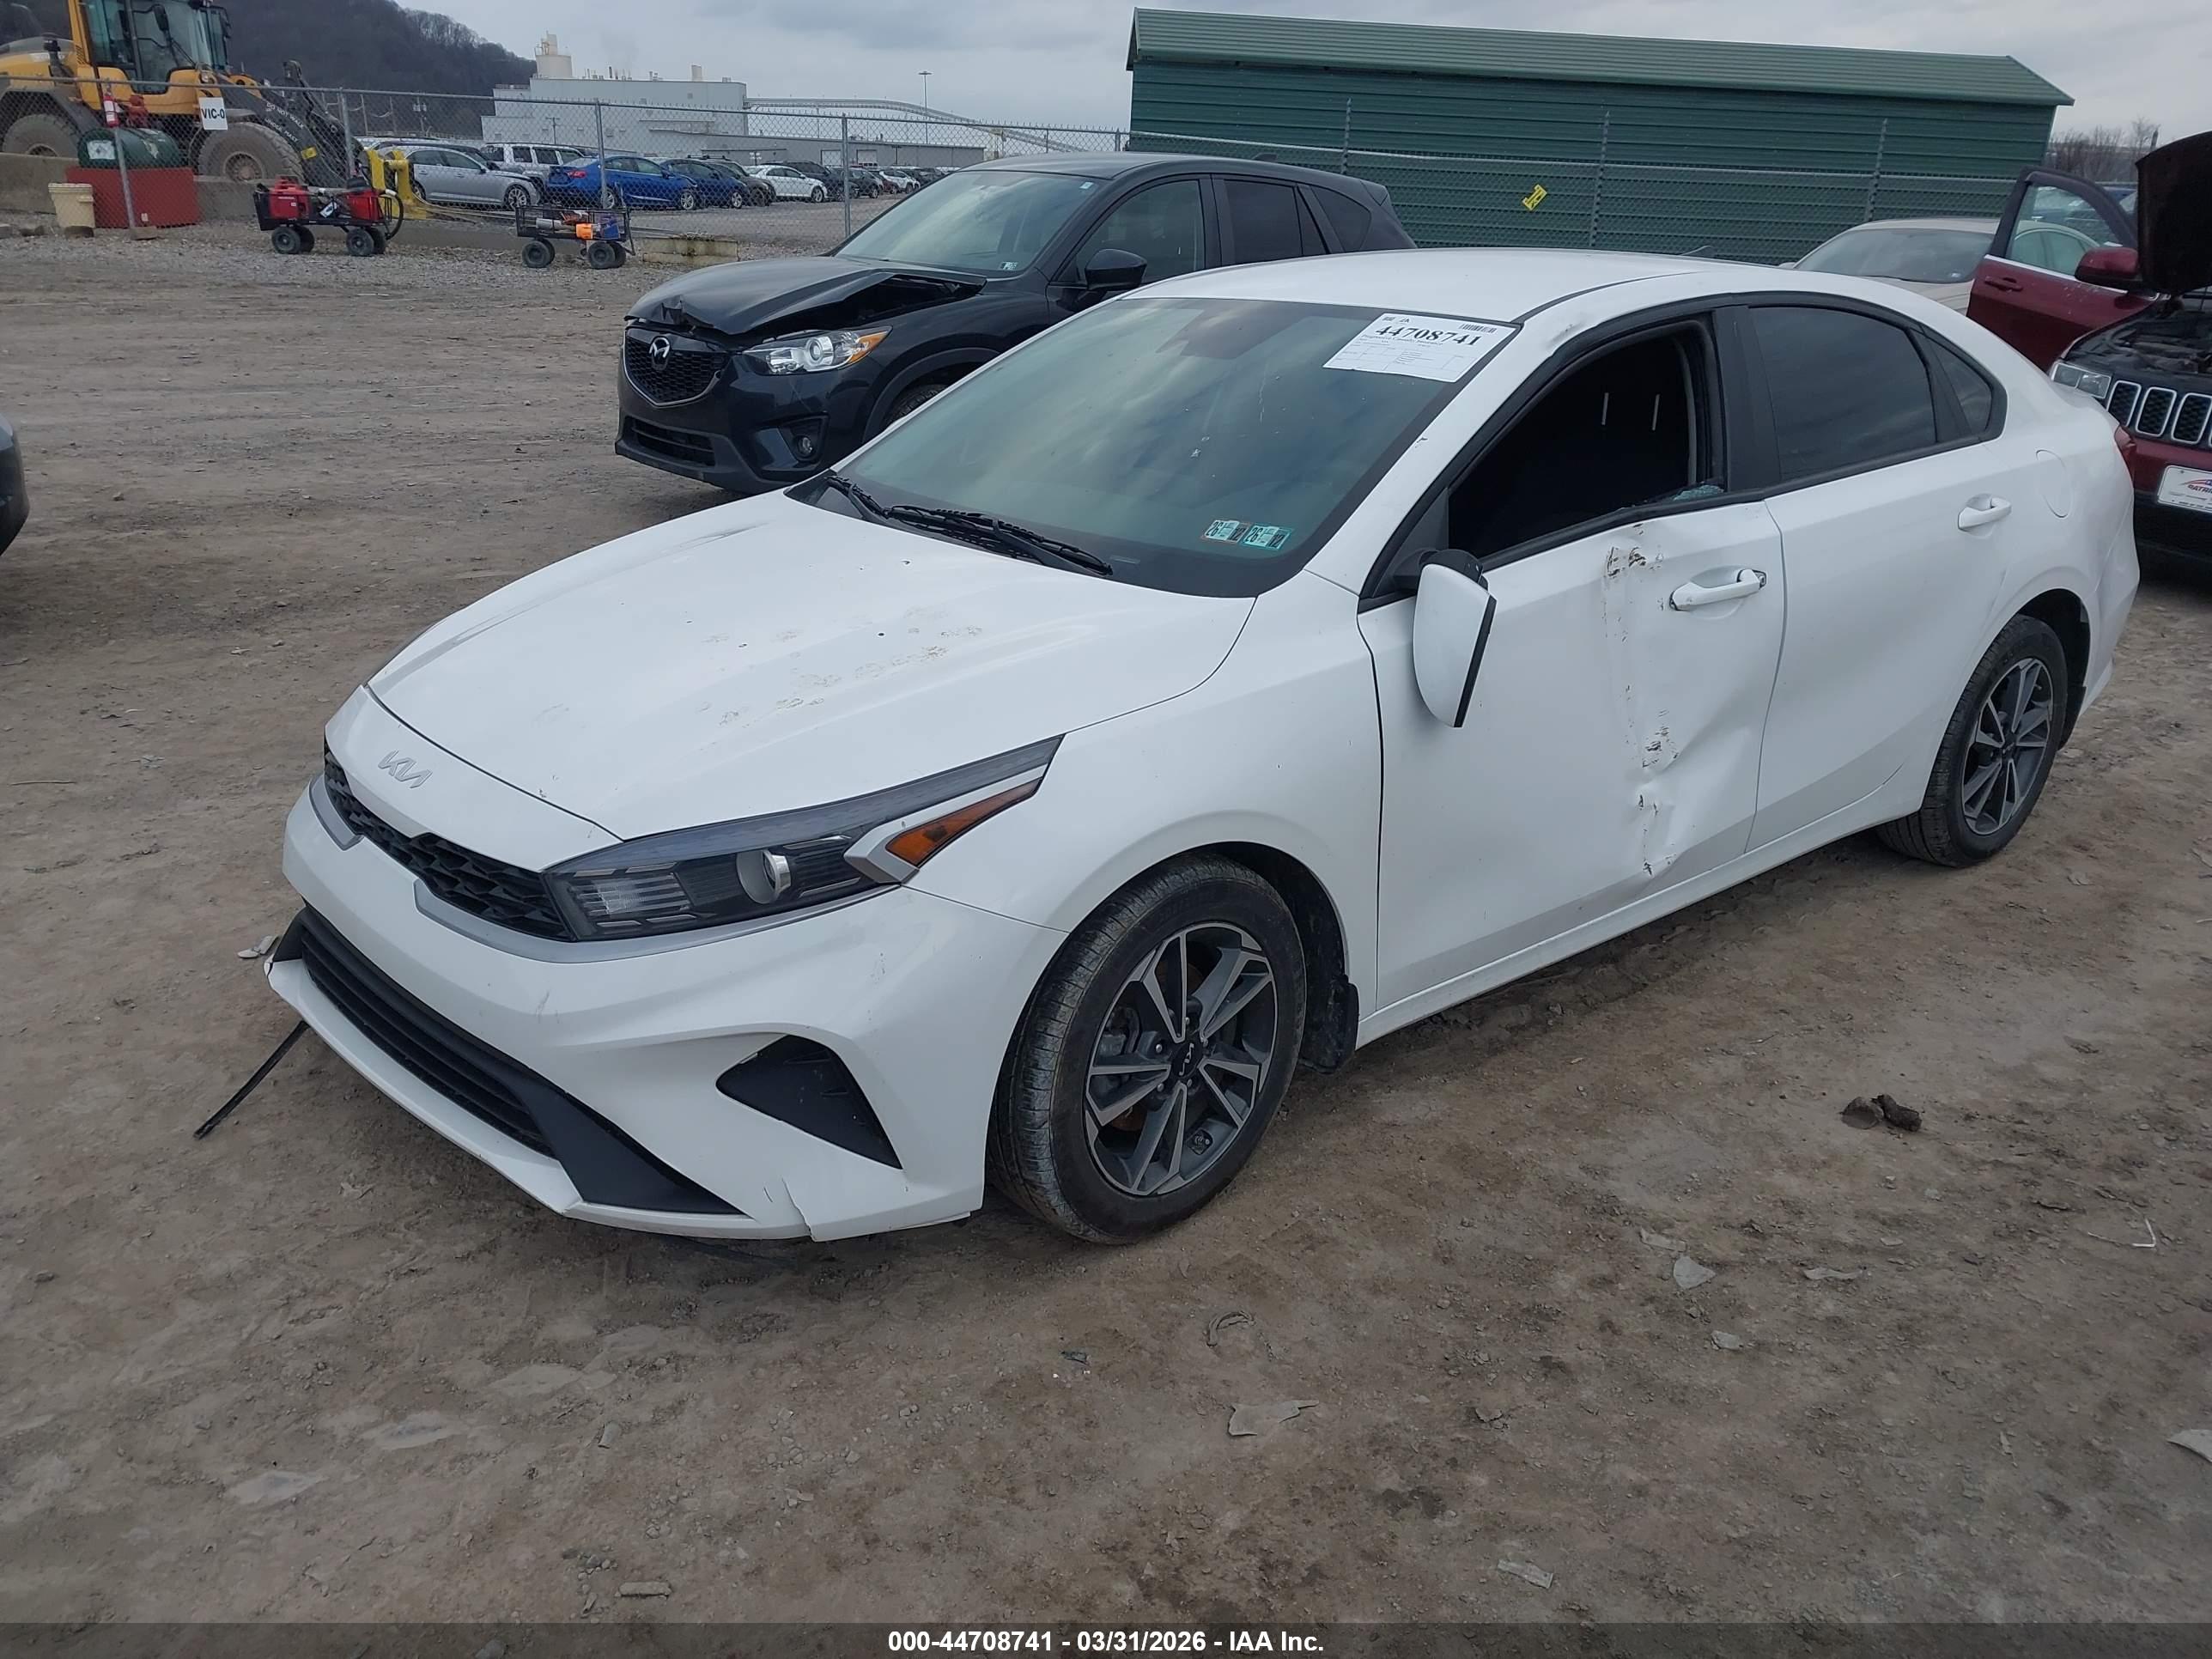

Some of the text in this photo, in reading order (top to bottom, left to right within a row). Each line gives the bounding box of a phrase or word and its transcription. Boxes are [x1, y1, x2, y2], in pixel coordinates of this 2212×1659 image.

[1376, 325, 1482, 346] 44708741
[2187, 484, 2212, 494] PATRI
[1206, 521, 1223, 537] 26
[1245, 527, 1263, 543] 26
